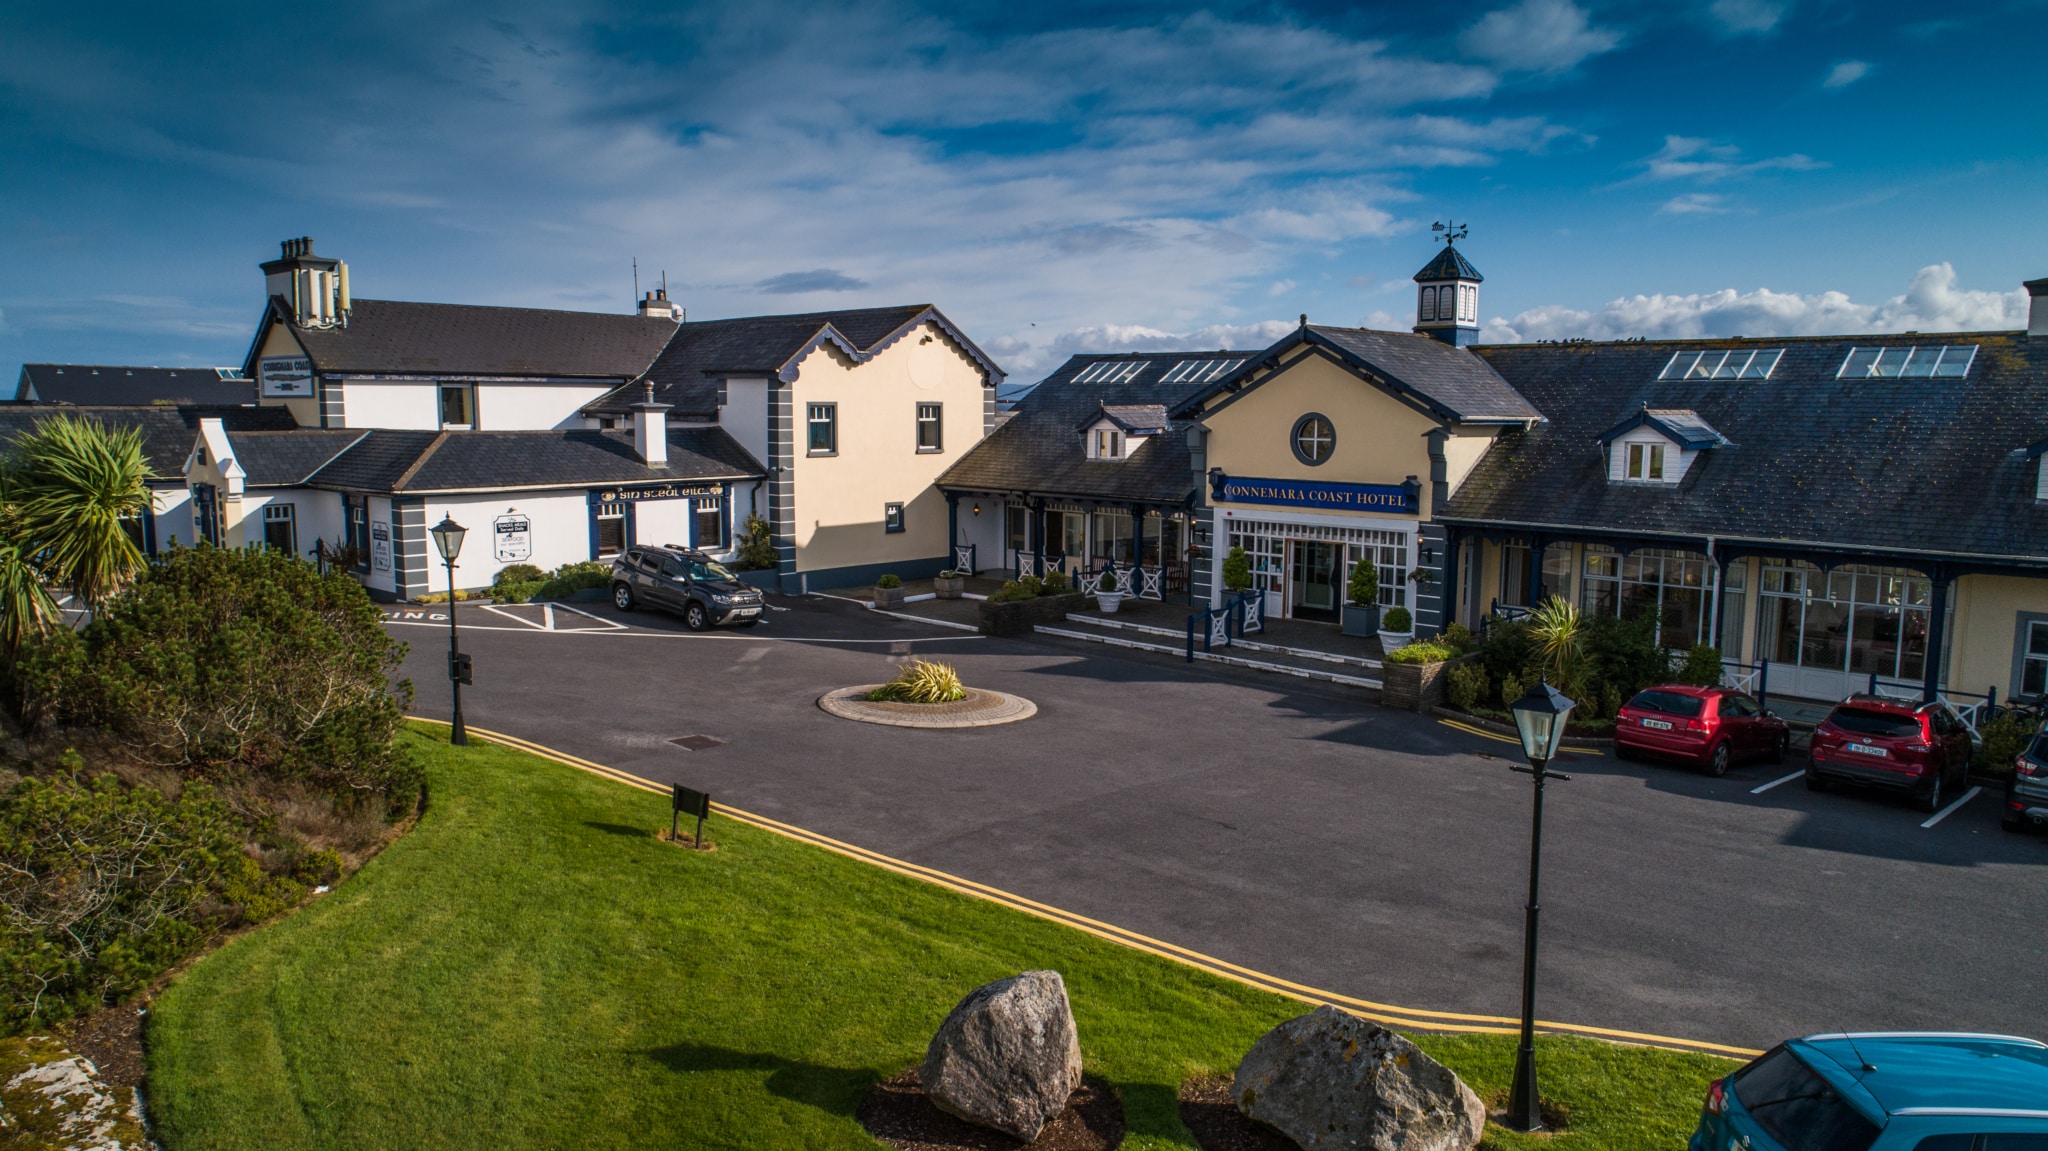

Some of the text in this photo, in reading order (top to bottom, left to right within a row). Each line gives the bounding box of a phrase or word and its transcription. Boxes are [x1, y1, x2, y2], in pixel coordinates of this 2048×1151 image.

[1224, 485, 1406, 507] CONNEMARA COAST HOTEL
